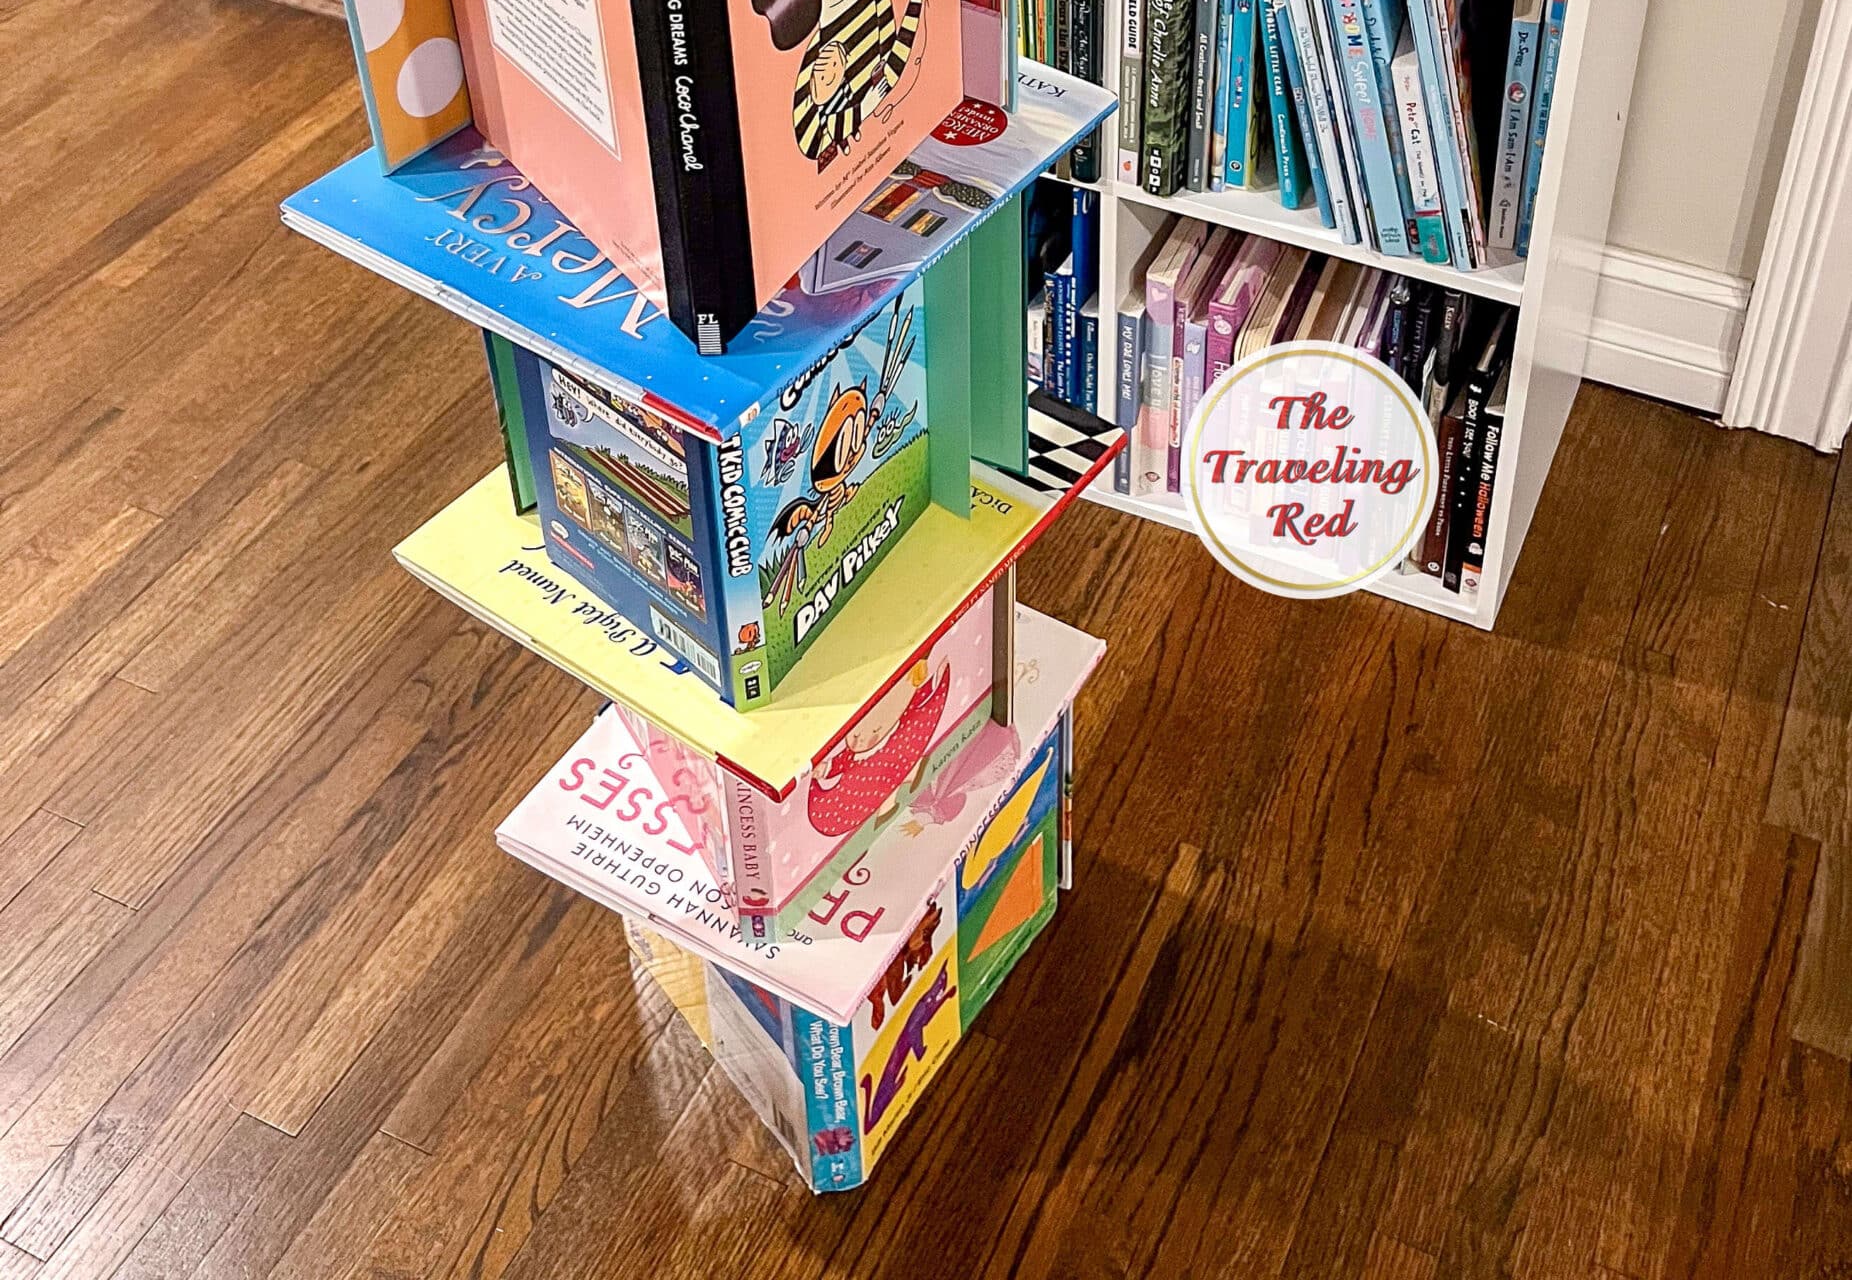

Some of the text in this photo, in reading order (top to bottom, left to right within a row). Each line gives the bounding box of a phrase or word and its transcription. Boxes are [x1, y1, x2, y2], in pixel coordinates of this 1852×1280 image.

[669, 11, 688, 66] DREAMS
[1057, 27, 1070, 47] the
[1128, 18, 1138, 49] GUIDE
[1150, 18, 1169, 69] Charlie
[1513, 31, 1529, 68] Dr. Seuss
[1197, 44, 1207, 77] Creatures
[1268, 44, 1281, 74] LITTLE
[673, 74, 696, 116] Coco
[1150, 69, 1164, 108] Anne
[1351, 60, 1372, 106] Sweet
[678, 111, 704, 173] Chanel
[941, 118, 994, 142] MERC
[1405, 101, 1421, 146] Pete Cat
[1508, 115, 1520, 131] Am
[424, 227, 512, 276] VERY
[698, 313, 719, 324] FL
[1471, 424, 1500, 538] Follow Me Halloween
[727, 534, 754, 579] CLUB
[498, 559, 636, 644] Piglet Named
[793, 569, 840, 648] DAV
[565, 813, 686, 884] OPPENHEIM
[570, 842, 662, 897] GUTHRIE
[742, 845, 761, 880] BABY
[809, 1020, 829, 1101] What Do You See?
[830, 1046, 849, 1123] Bear, Brown Bear,
